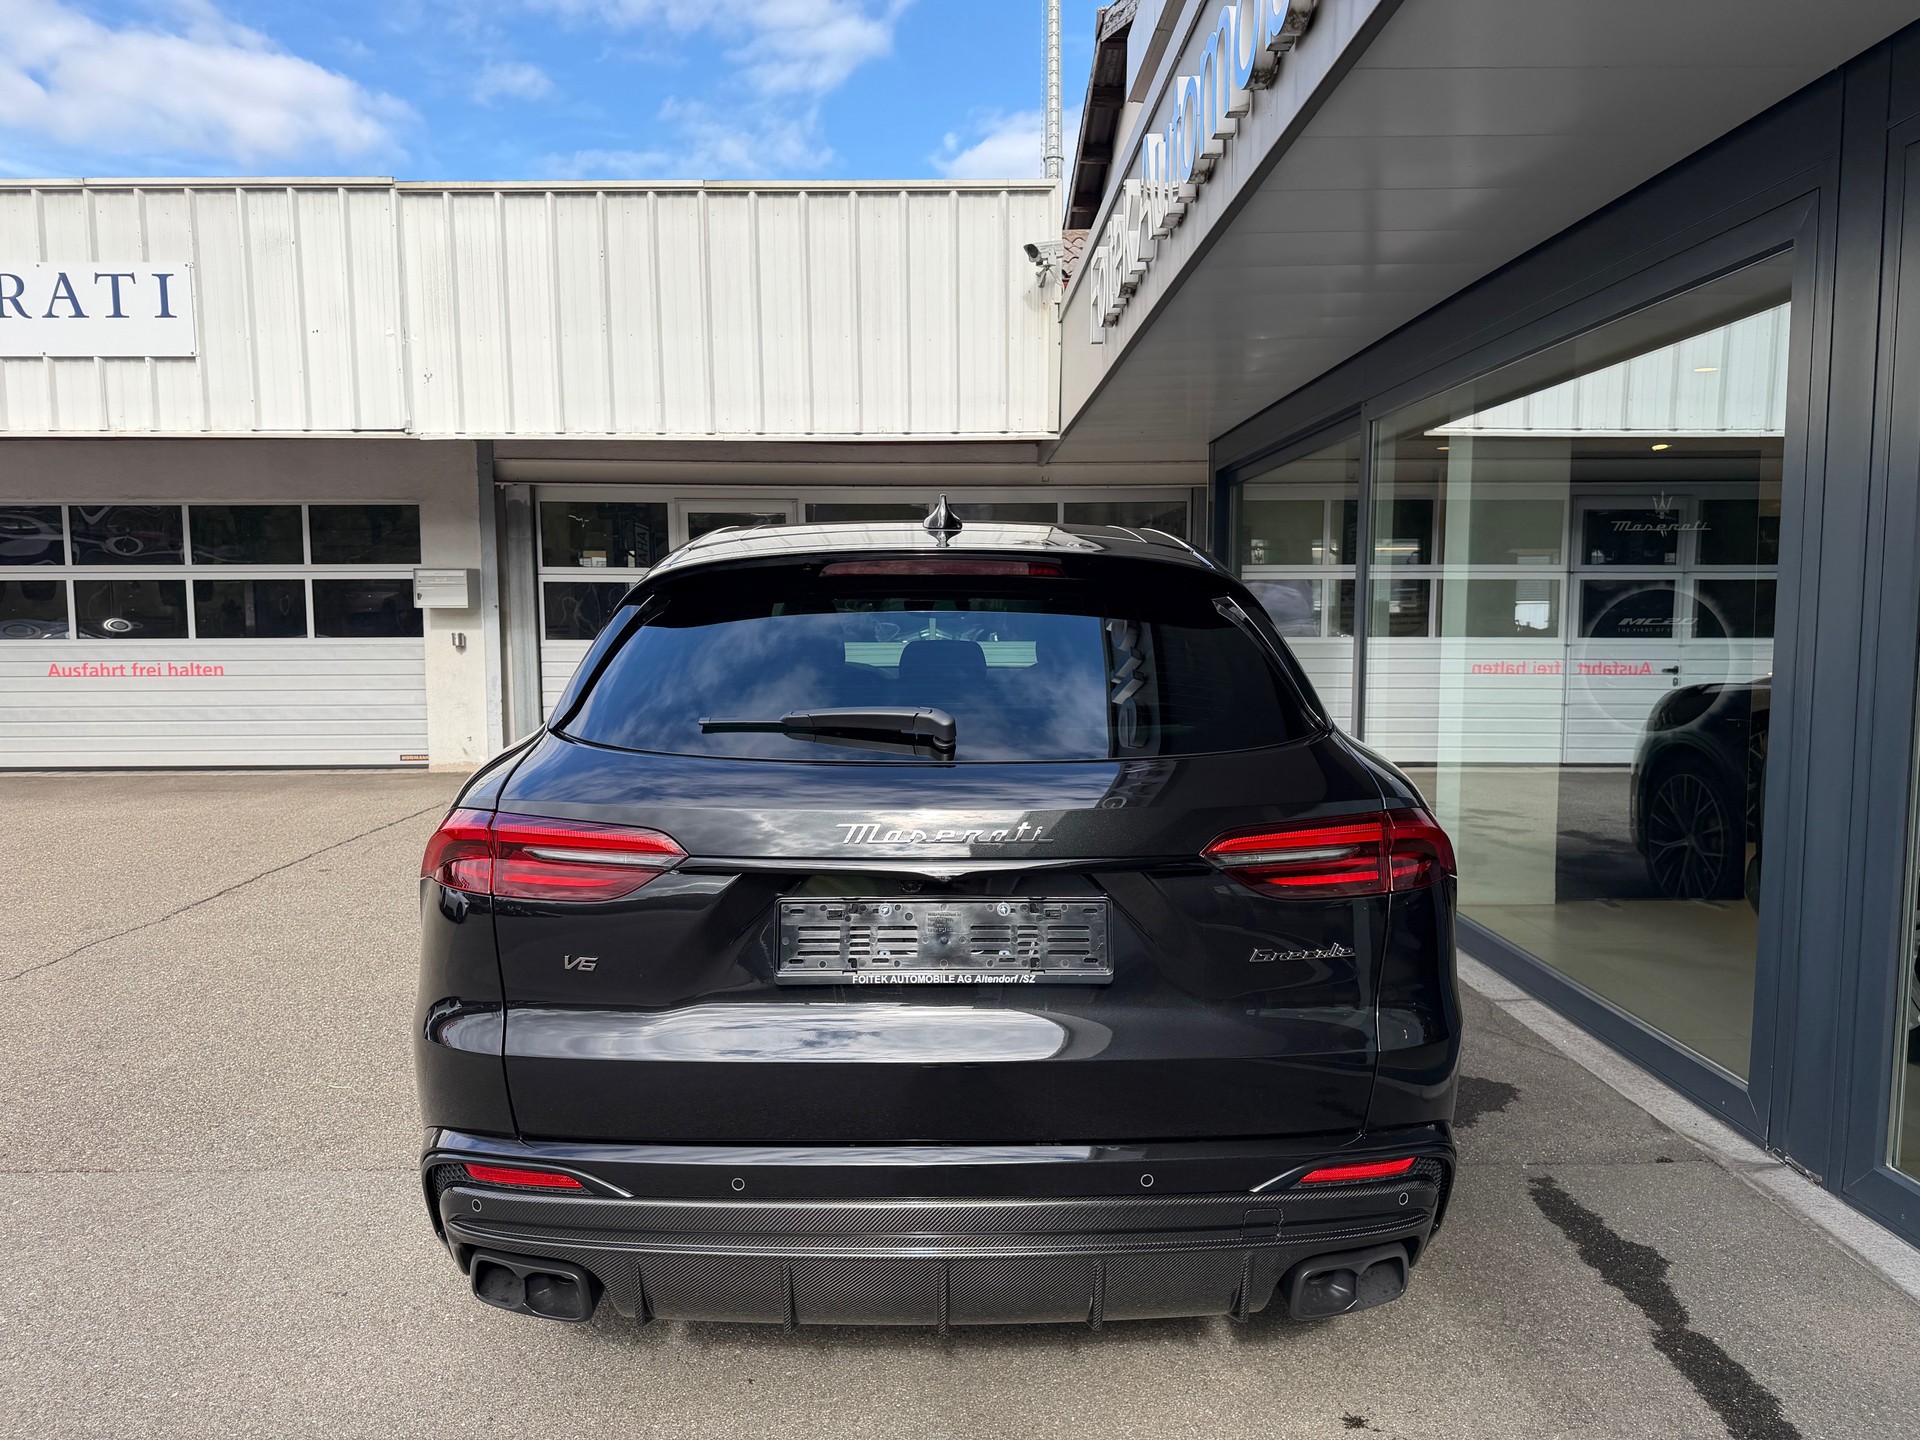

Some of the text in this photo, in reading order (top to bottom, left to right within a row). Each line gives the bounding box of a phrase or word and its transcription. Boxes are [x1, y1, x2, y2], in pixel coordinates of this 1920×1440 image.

[0, 272, 178, 319] RATI
[1611, 520, 1711, 532] Maserati
[48, 662, 225, 678] Ausfahrt frei halten
[836, 821, 1054, 845] Maserati
[564, 954, 599, 972] V6
[852, 975, 1036, 984] FOITEK AUTOMOBILE AG Altendorf /SZ
